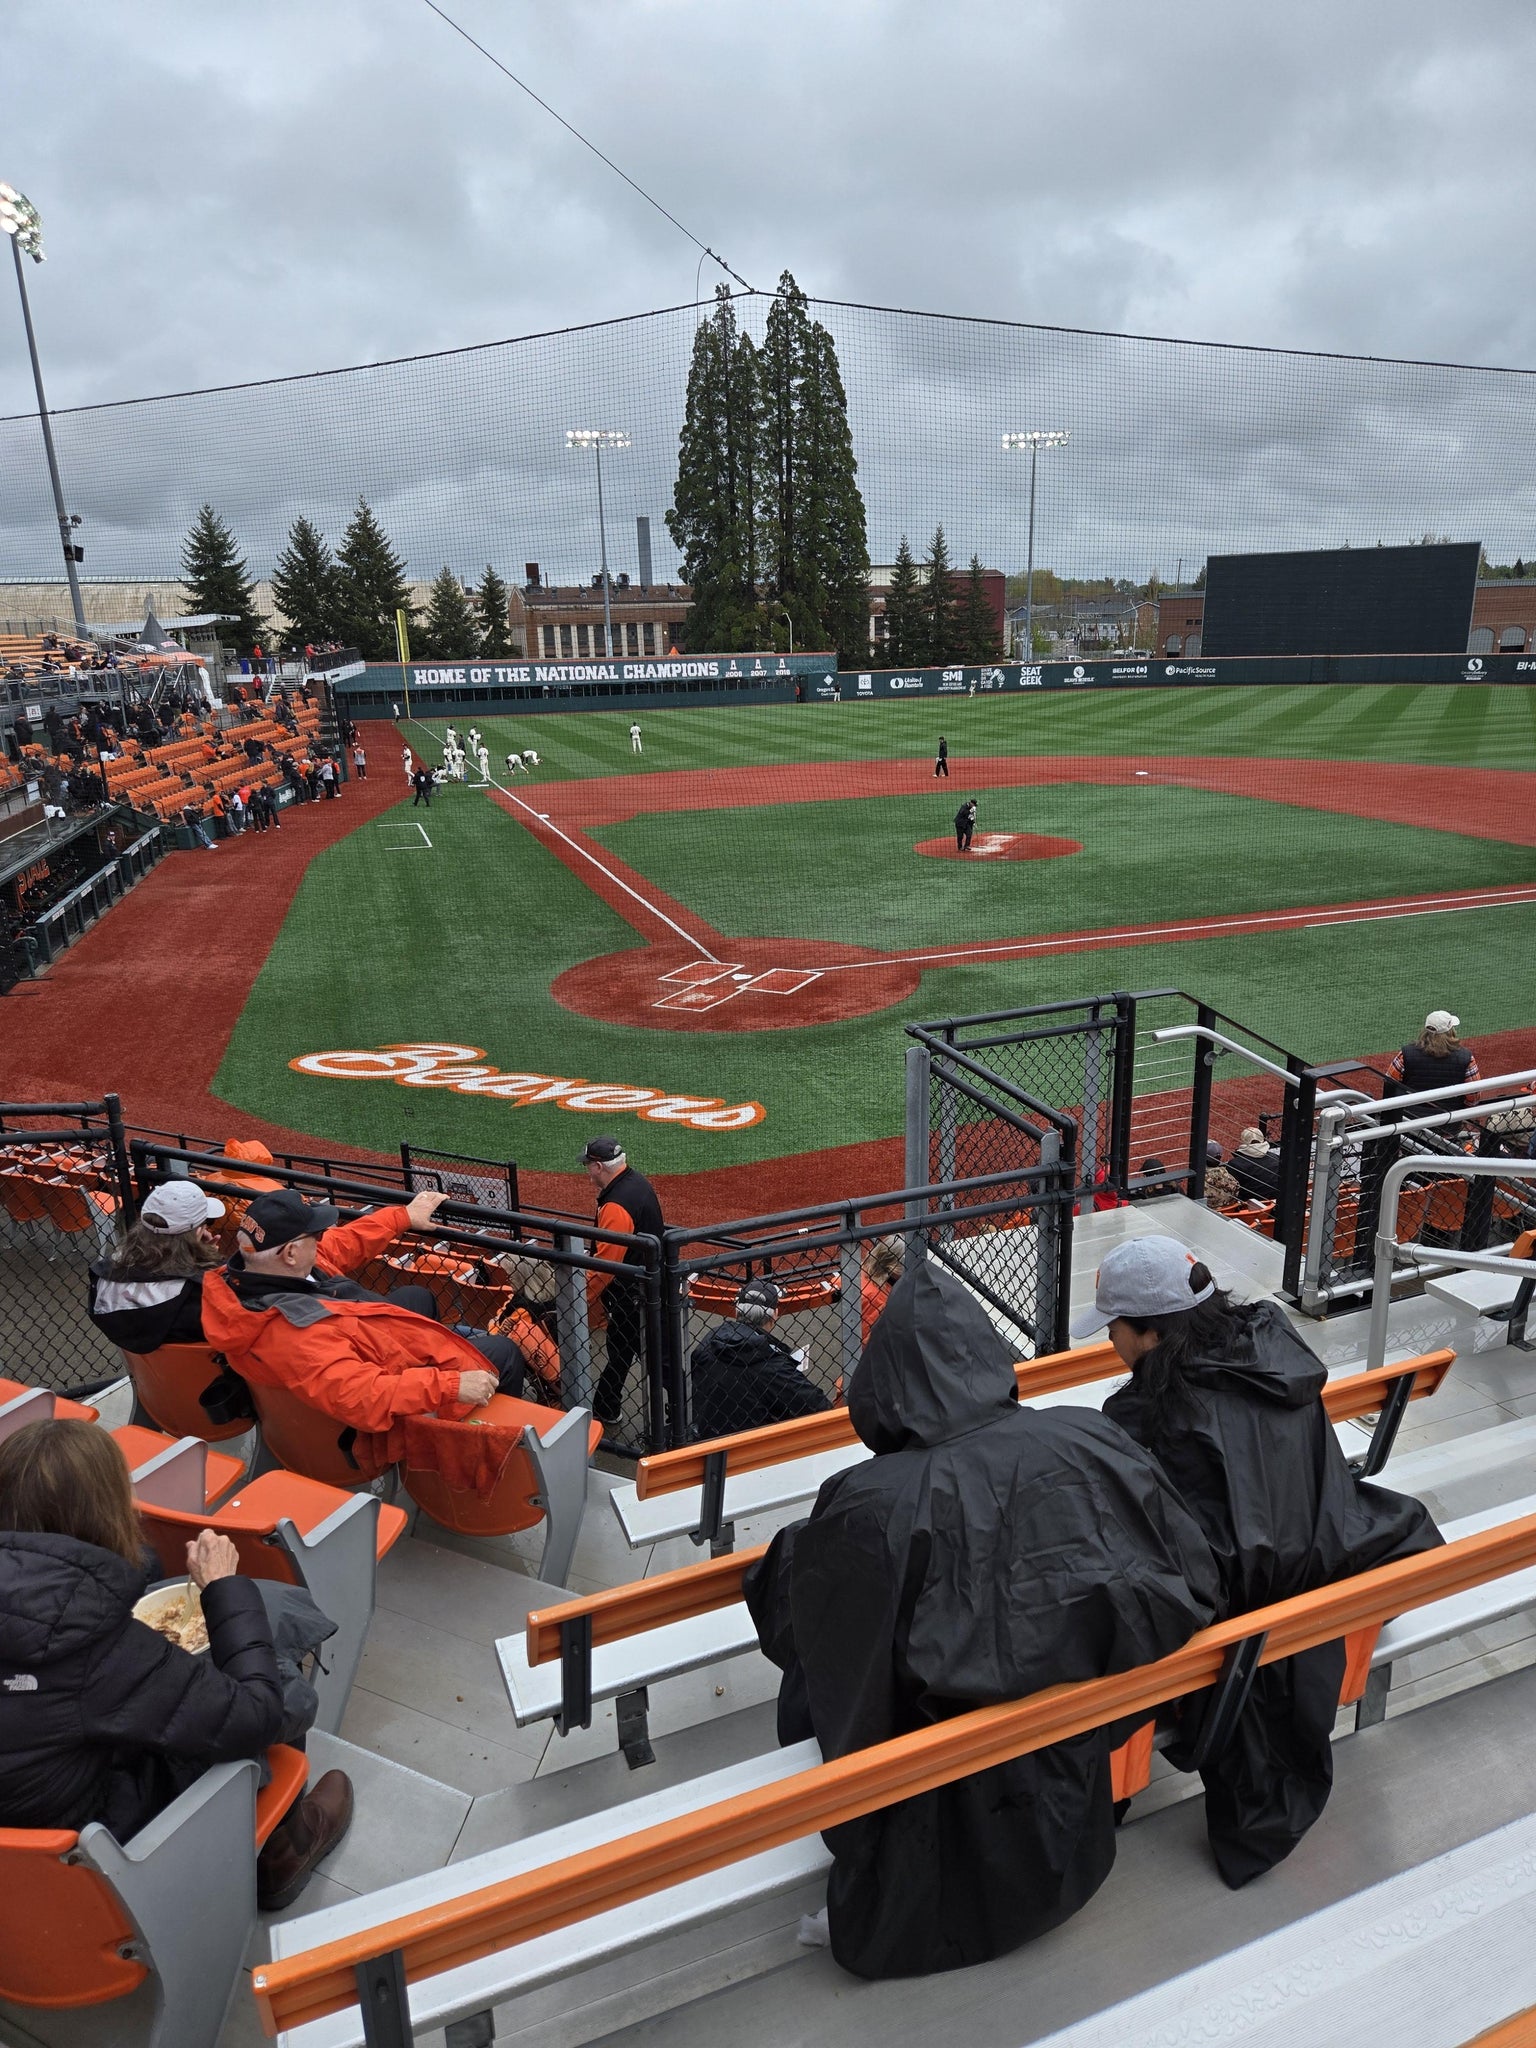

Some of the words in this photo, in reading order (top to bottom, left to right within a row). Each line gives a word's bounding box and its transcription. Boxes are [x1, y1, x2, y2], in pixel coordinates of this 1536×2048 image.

[414, 668, 466, 685] HOME
[471, 667, 492, 683] OF
[495, 666, 531, 683] THE
[535, 664, 619, 682] NATIONAL
[623, 662, 719, 680] CHAMPIONS
[1021, 667, 1042, 676] SEAT
[1176, 666, 1216, 675] PacificSource
[1020, 675, 1042, 686] GEEK
[288, 1042, 767, 1131] Beavers
